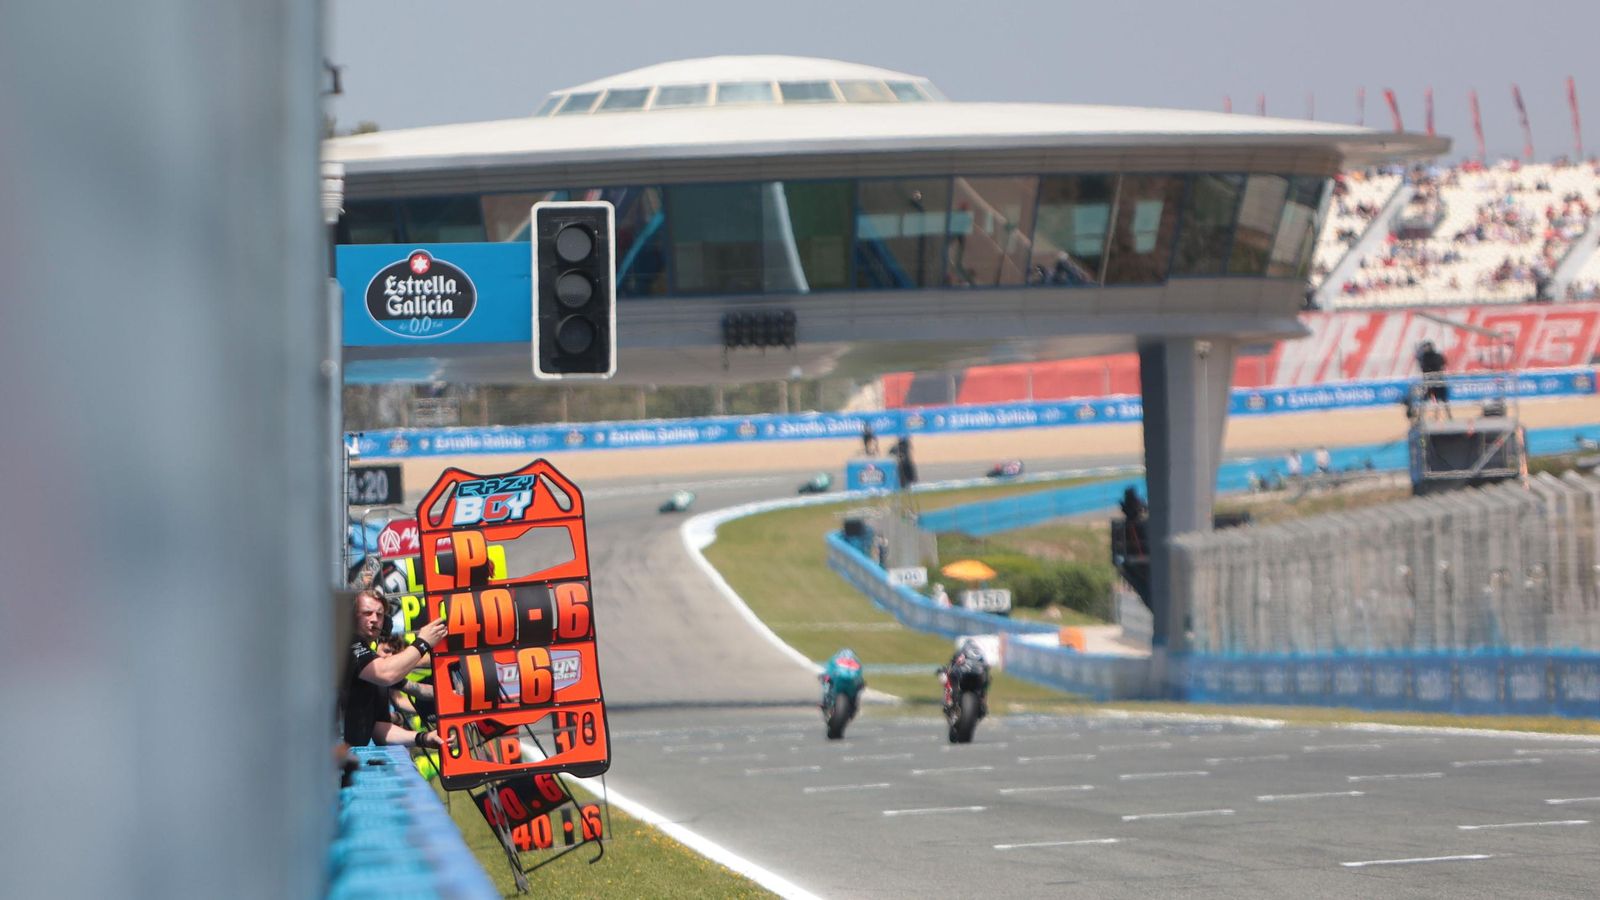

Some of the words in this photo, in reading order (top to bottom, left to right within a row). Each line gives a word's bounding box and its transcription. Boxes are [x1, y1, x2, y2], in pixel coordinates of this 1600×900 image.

[384, 275, 457, 295] Estrella
[386, 295, 454, 316] Galicia
[458, 475, 535, 496] CRAZY
[453, 489, 534, 525] BOY
[453, 530, 488, 588] P
[517, 647, 553, 704] 6
